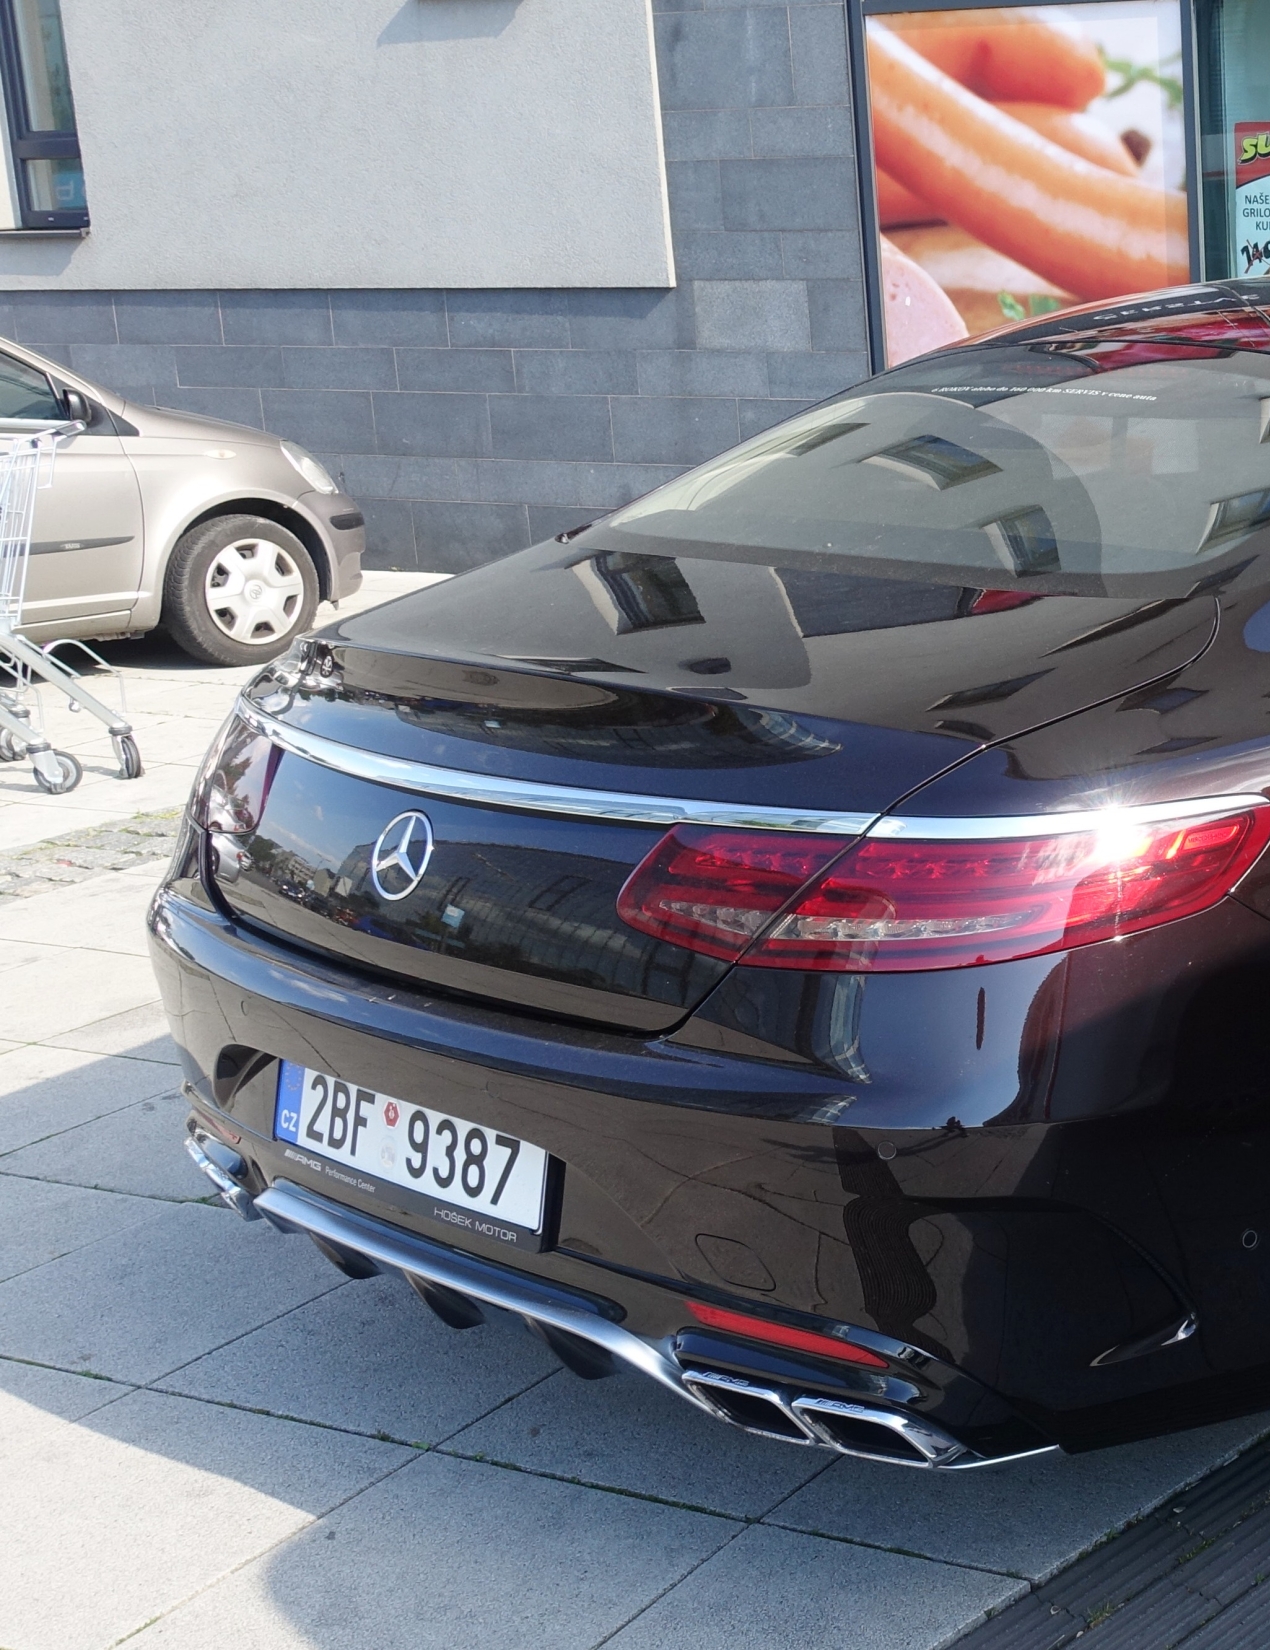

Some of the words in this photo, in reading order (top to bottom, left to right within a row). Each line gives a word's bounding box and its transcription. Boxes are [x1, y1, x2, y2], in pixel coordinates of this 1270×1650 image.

[1244, 192, 1270, 205] NAŠE
[1062, 388, 1102, 396] SERVIS
[280, 1108, 298, 1133] CZ
[305, 1074, 376, 1157] 2BF
[405, 1109, 521, 1207] 9387
[325, 1166, 358, 1187] Performance
[357, 1178, 376, 1193] Center
[433, 1206, 473, 1230] HOŠEK
[475, 1221, 517, 1243] MOTOR
